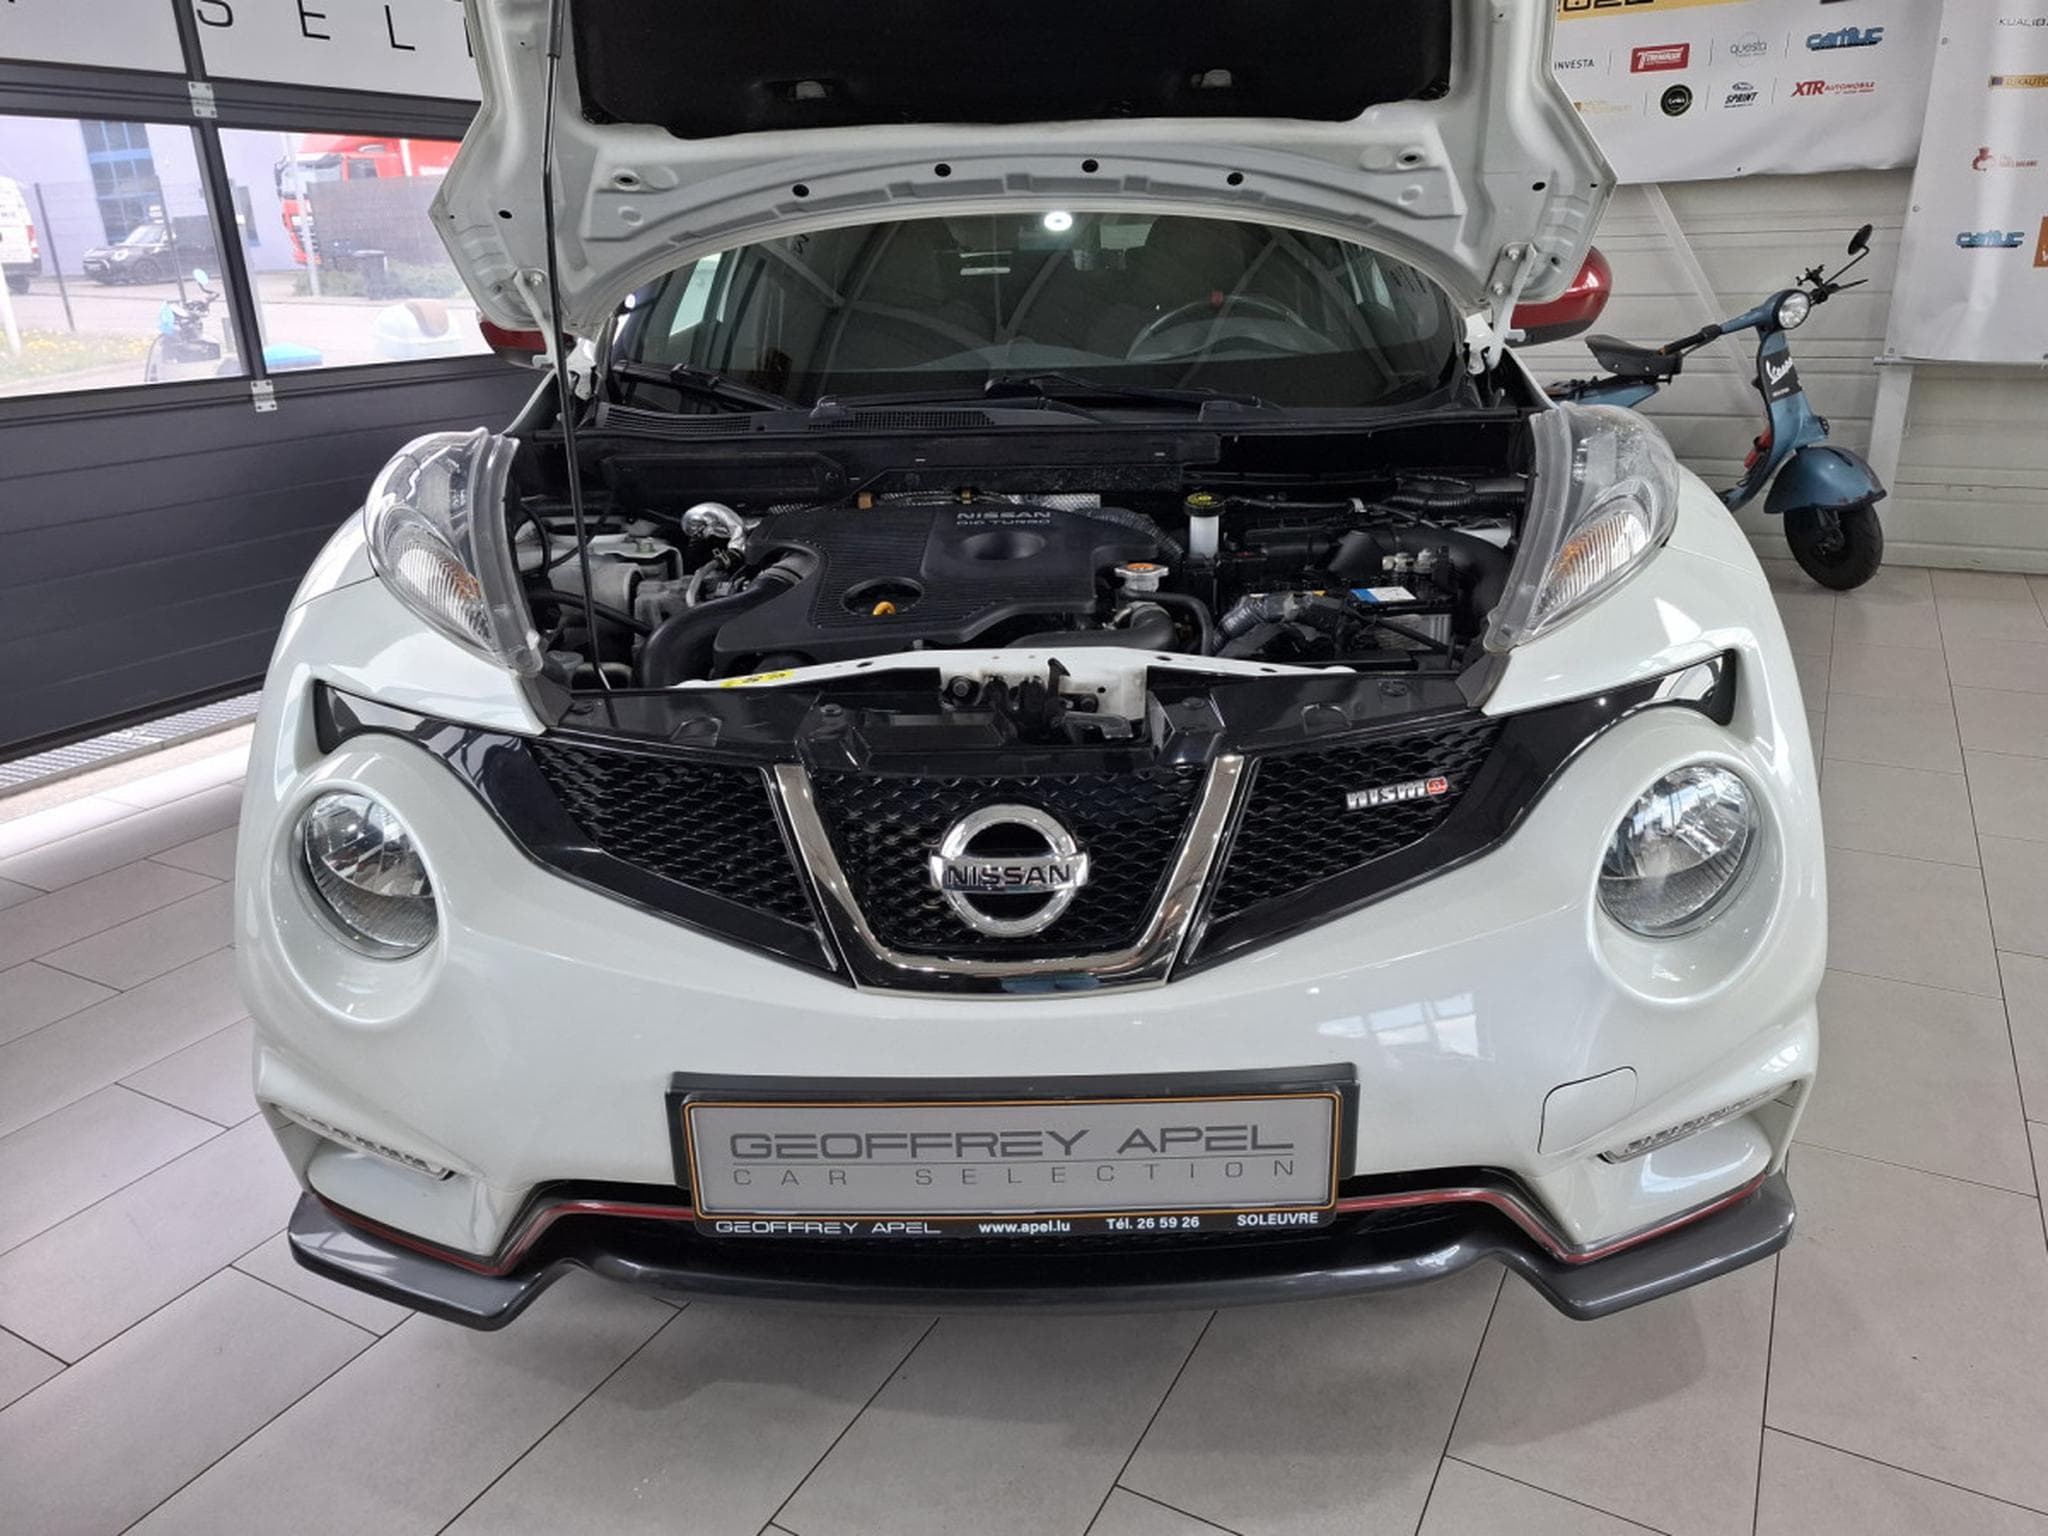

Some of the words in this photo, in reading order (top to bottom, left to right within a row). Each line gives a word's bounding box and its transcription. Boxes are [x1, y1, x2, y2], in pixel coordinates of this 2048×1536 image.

[196, 0, 474, 58] SEL
[1554, 59, 1595, 70] INVESTA
[1791, 80, 1825, 97] XTR
[956, 511, 1051, 520] NISSAN
[948, 863, 1071, 886] NISSAN
[729, 1129, 1090, 1159] GEOFFREY
[1116, 1124, 1294, 1154] APEL
[733, 1168, 848, 1186] CAR
[915, 1159, 1294, 1186] SELECTION
[715, 1220, 857, 1234] GEOFFREY
[871, 1221, 942, 1234] APEL
[978, 1219, 1071, 1236] www.apel.lu
[1106, 1217, 1134, 1230] Tél.
[1136, 1217, 1155, 1230] 26
[1159, 1217, 1177, 1229] 59
[1181, 1217, 1200, 1229] 26
[1236, 1212, 1319, 1226] SOLEUVRE
